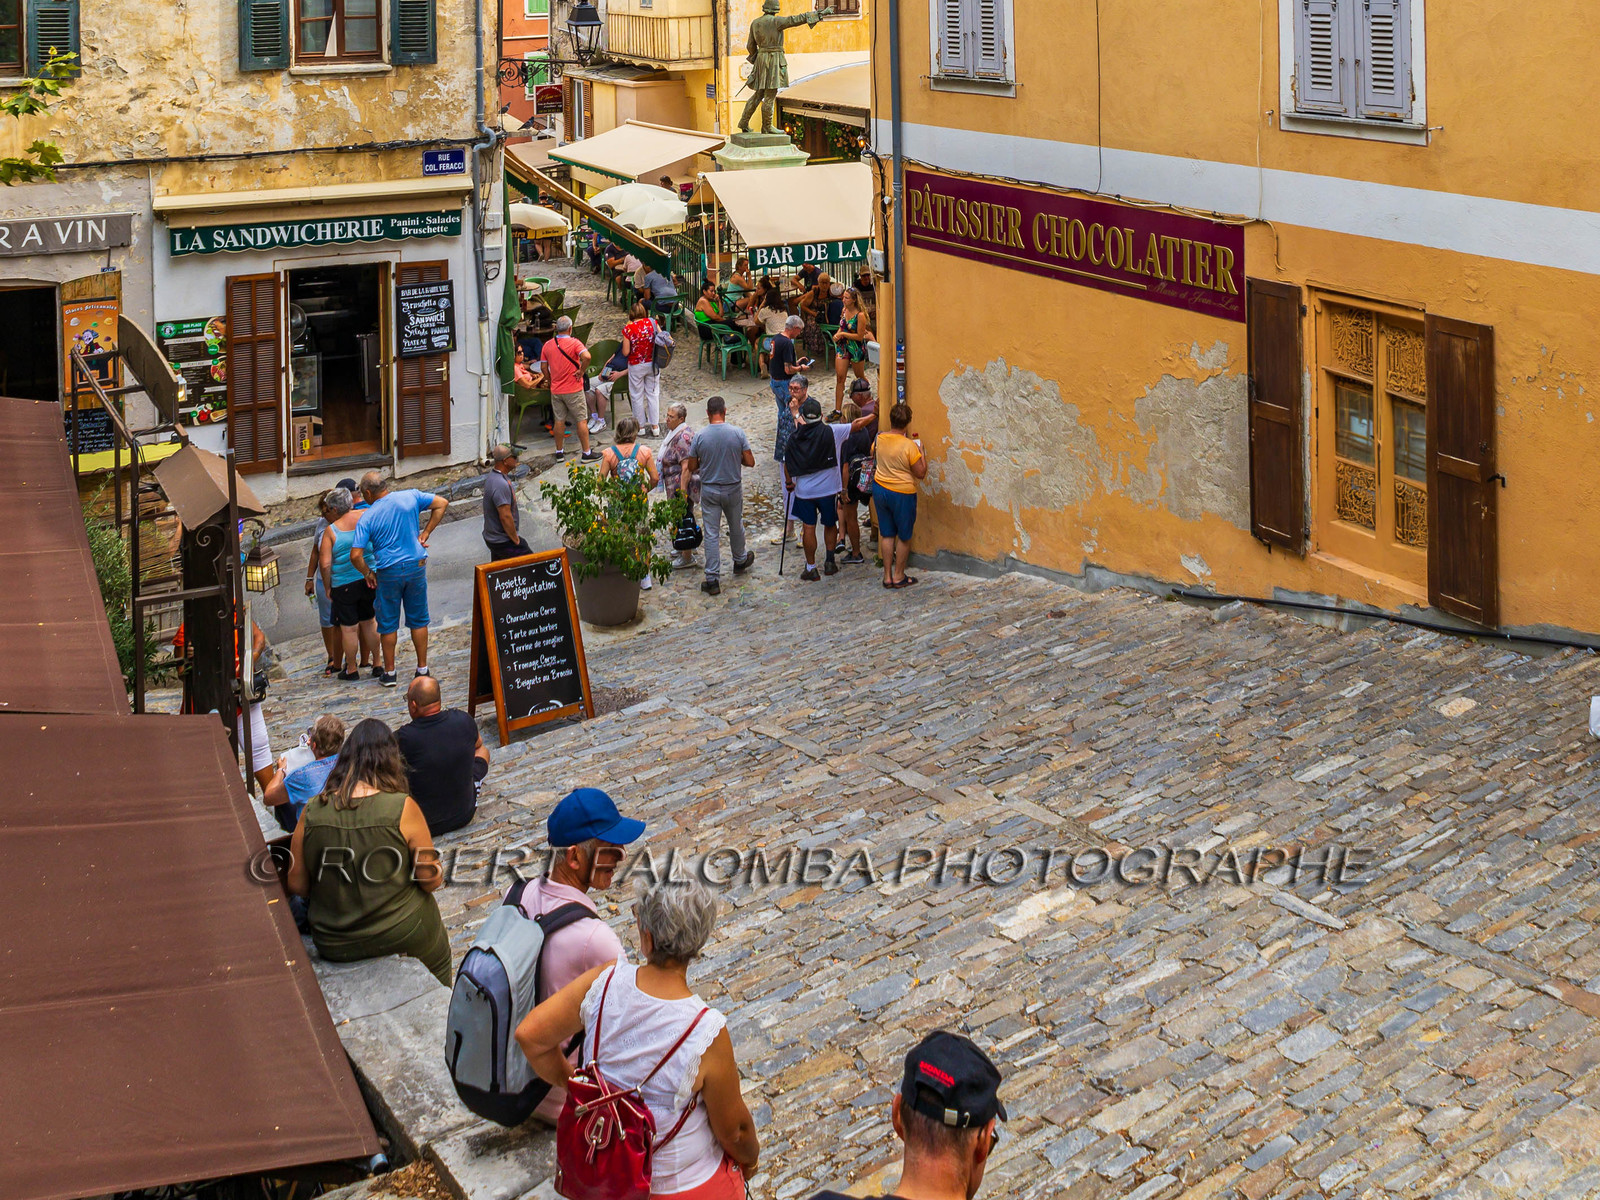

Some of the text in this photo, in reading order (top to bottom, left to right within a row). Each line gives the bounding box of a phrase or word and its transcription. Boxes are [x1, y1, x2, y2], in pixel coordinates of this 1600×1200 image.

[438, 153, 450, 161] RUE
[439, 162, 464, 170] FERACCI
[390, 215, 461, 227] Panini Salades
[54, 219, 107, 245] VIN
[173, 218, 385, 251] LA SANDWICHERIE
[401, 225, 449, 236] Bruschette
[909, 183, 1239, 295] PÂTISSIER CHOCOLATIER
[756, 240, 862, 266] BAR DE LA
[495, 575, 527, 591] Assiette
[502, 580, 557, 600] de dégustation
[540, 606, 557, 616] Corse
[509, 629, 527, 640] Tarte
[510, 643, 533, 653] Terrine
[534, 640, 541, 648] de
[513, 660, 539, 671] Fromage
[540, 654, 557, 665] Corse
[515, 675, 541, 690] Beignets
[919, 1060, 955, 1086] HONDA
